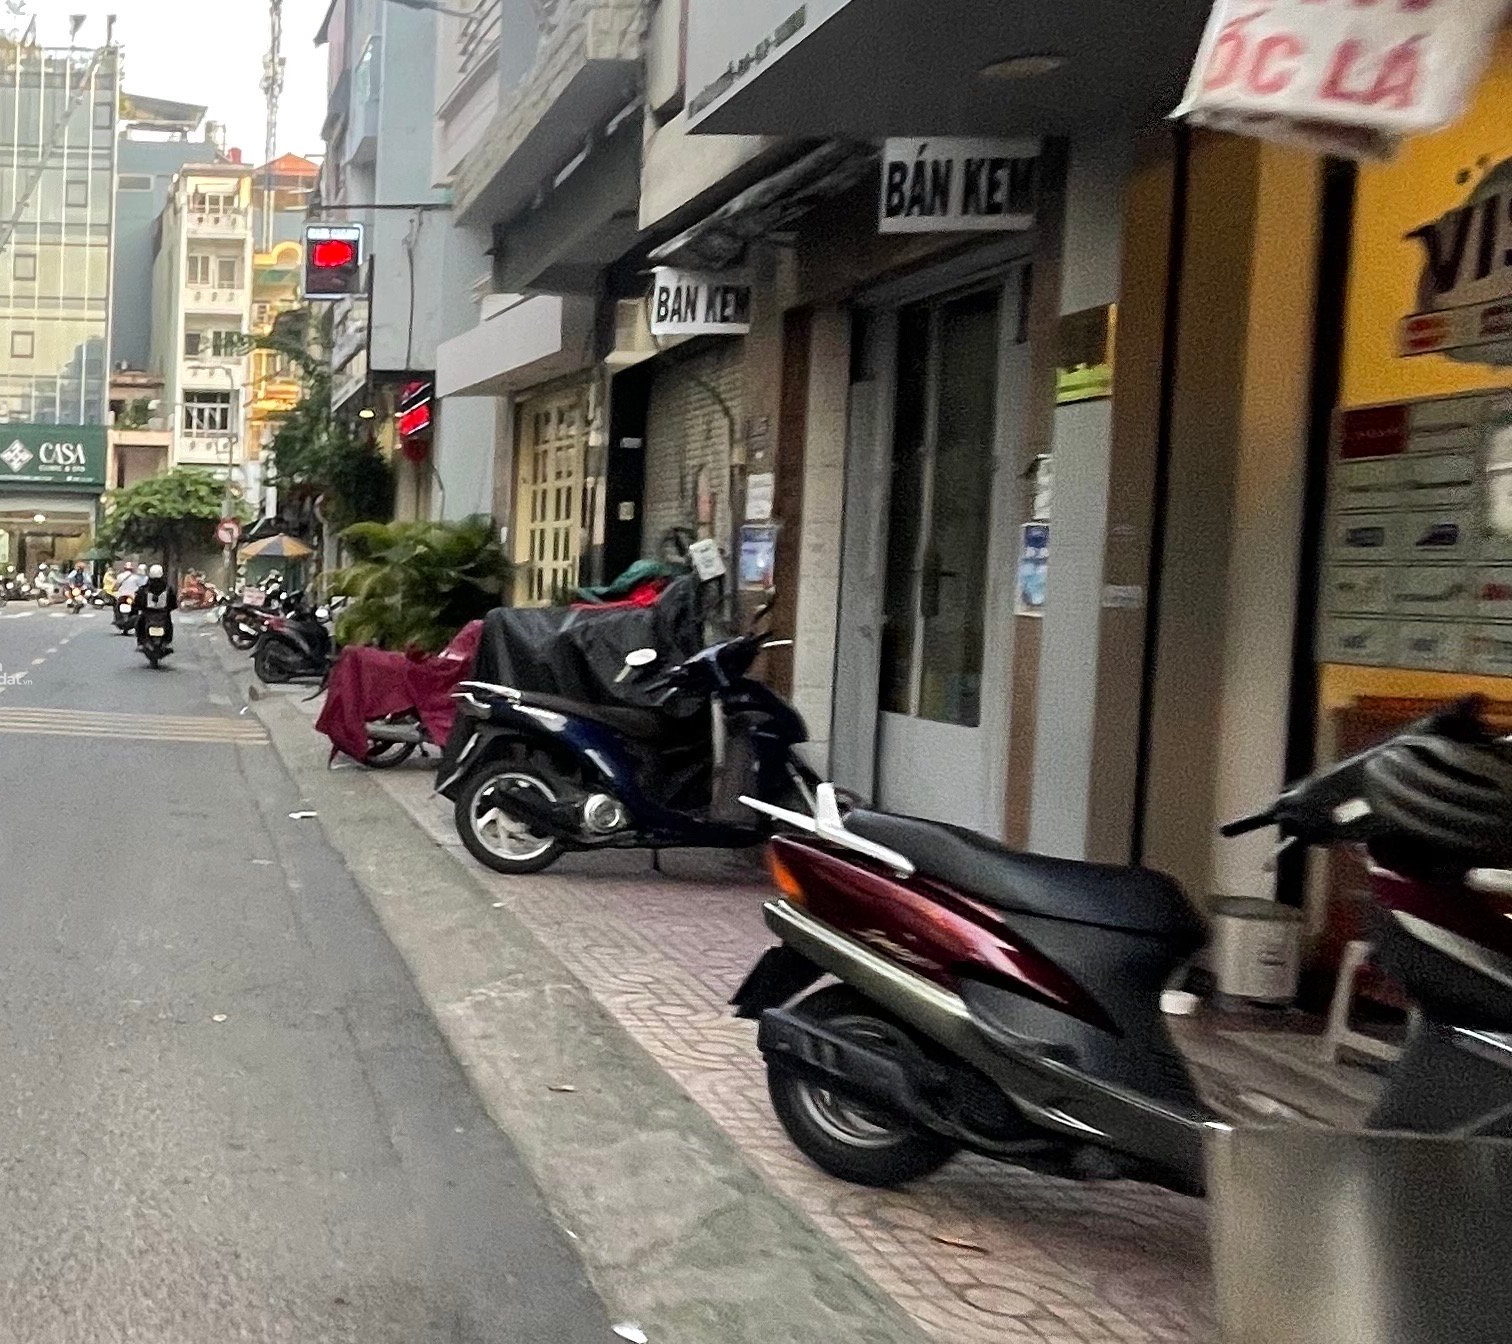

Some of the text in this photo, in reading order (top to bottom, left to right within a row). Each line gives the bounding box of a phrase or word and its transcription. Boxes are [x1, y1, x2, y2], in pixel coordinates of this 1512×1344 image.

[1319, 32, 1433, 110] LÁ
[887, 143, 952, 218] BÁN
[1403, 193, 1512, 294] VI
[39, 442, 86, 465] CASA
